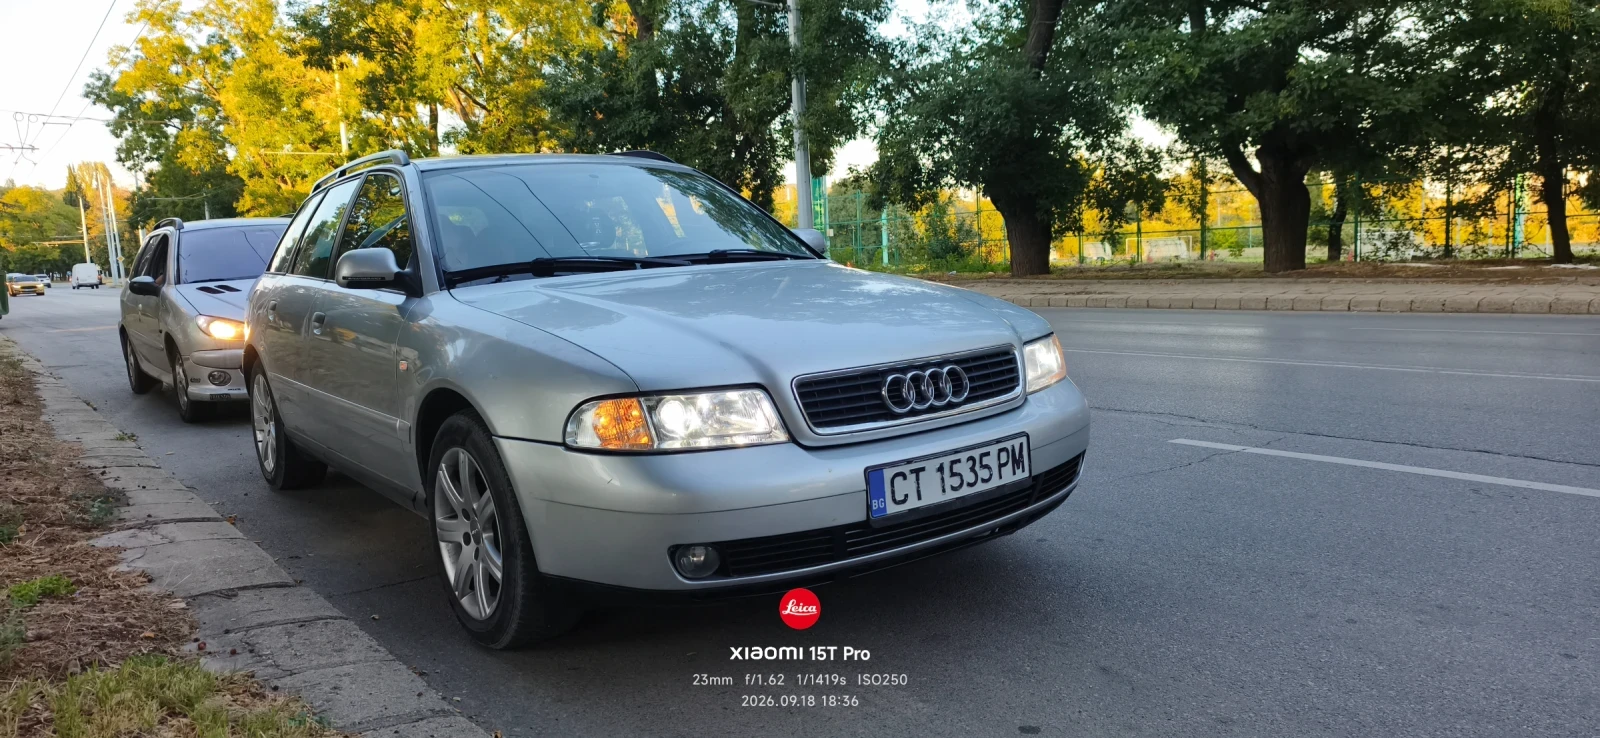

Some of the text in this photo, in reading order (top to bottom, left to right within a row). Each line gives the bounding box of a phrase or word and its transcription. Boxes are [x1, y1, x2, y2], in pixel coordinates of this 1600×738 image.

[890, 442, 1025, 506] CT 1535 PM
[872, 498, 885, 510] BG
